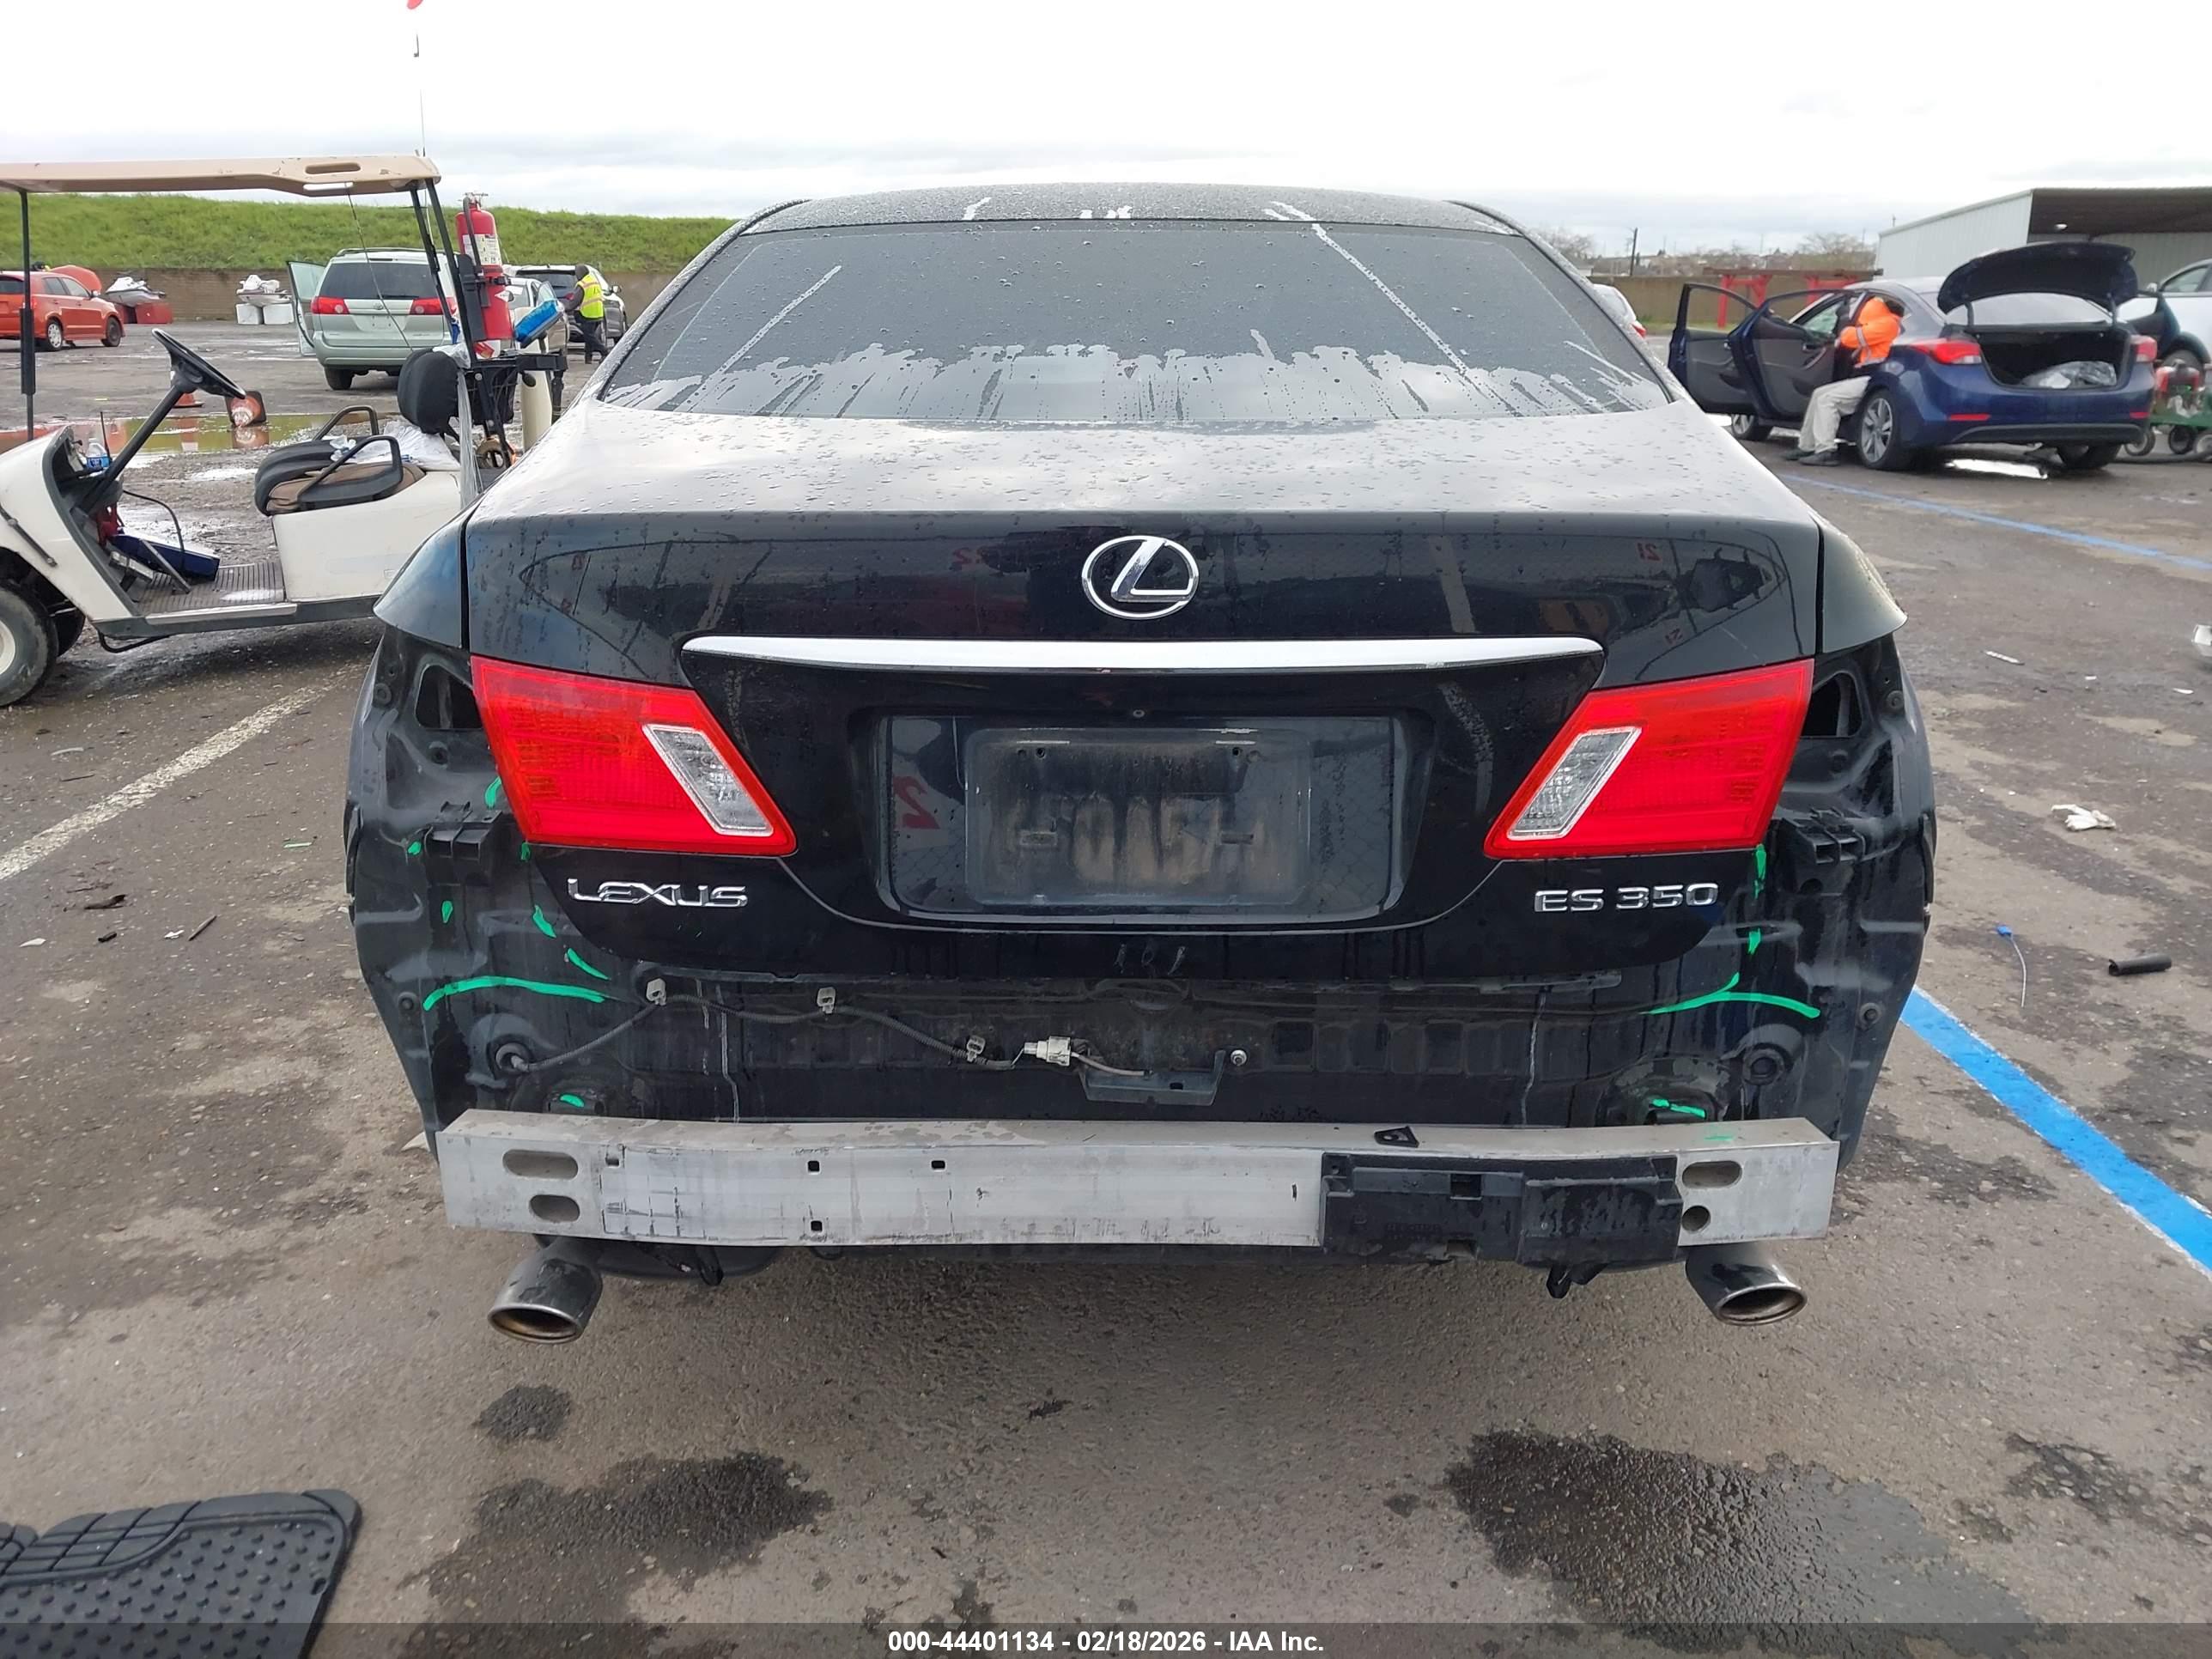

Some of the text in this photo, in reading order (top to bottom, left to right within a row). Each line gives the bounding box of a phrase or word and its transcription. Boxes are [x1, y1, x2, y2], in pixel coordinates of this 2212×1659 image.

[566, 877, 749, 908] LEXUS
[1533, 882, 1719, 913] ES 350
